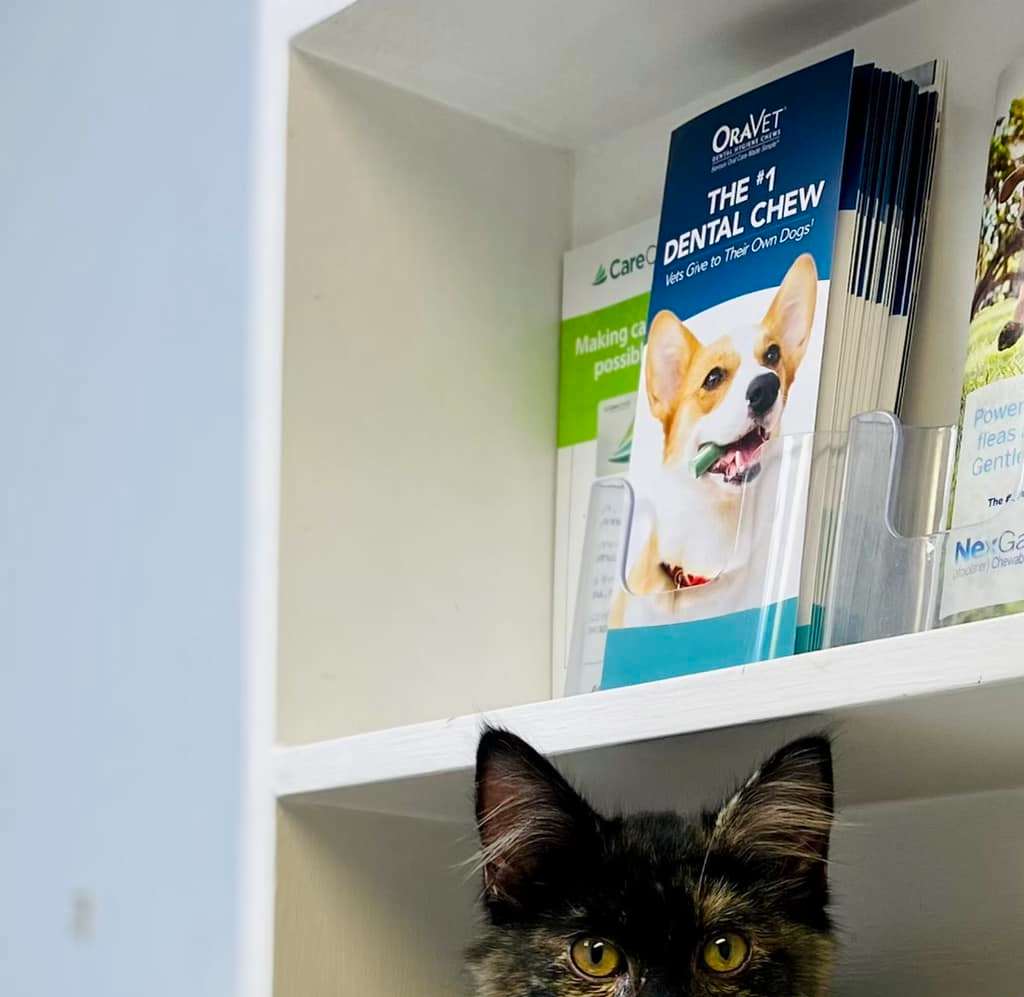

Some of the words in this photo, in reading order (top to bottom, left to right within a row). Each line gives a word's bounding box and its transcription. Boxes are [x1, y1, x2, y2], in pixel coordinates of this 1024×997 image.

[707, 176, 750, 215] THE
[756, 166, 776, 192] #1
[663, 211, 744, 266] DENTAL
[750, 180, 826, 228] CHEW
[666, 269, 685, 287] Vets
[686, 259, 709, 278] Give
[710, 255, 722, 269] to
[725, 242, 750, 263] Their
[751, 235, 778, 253] Own
[575, 325, 629, 355] Making
[977, 426, 1017, 450] fleas
[988, 497, 1003, 508] The
